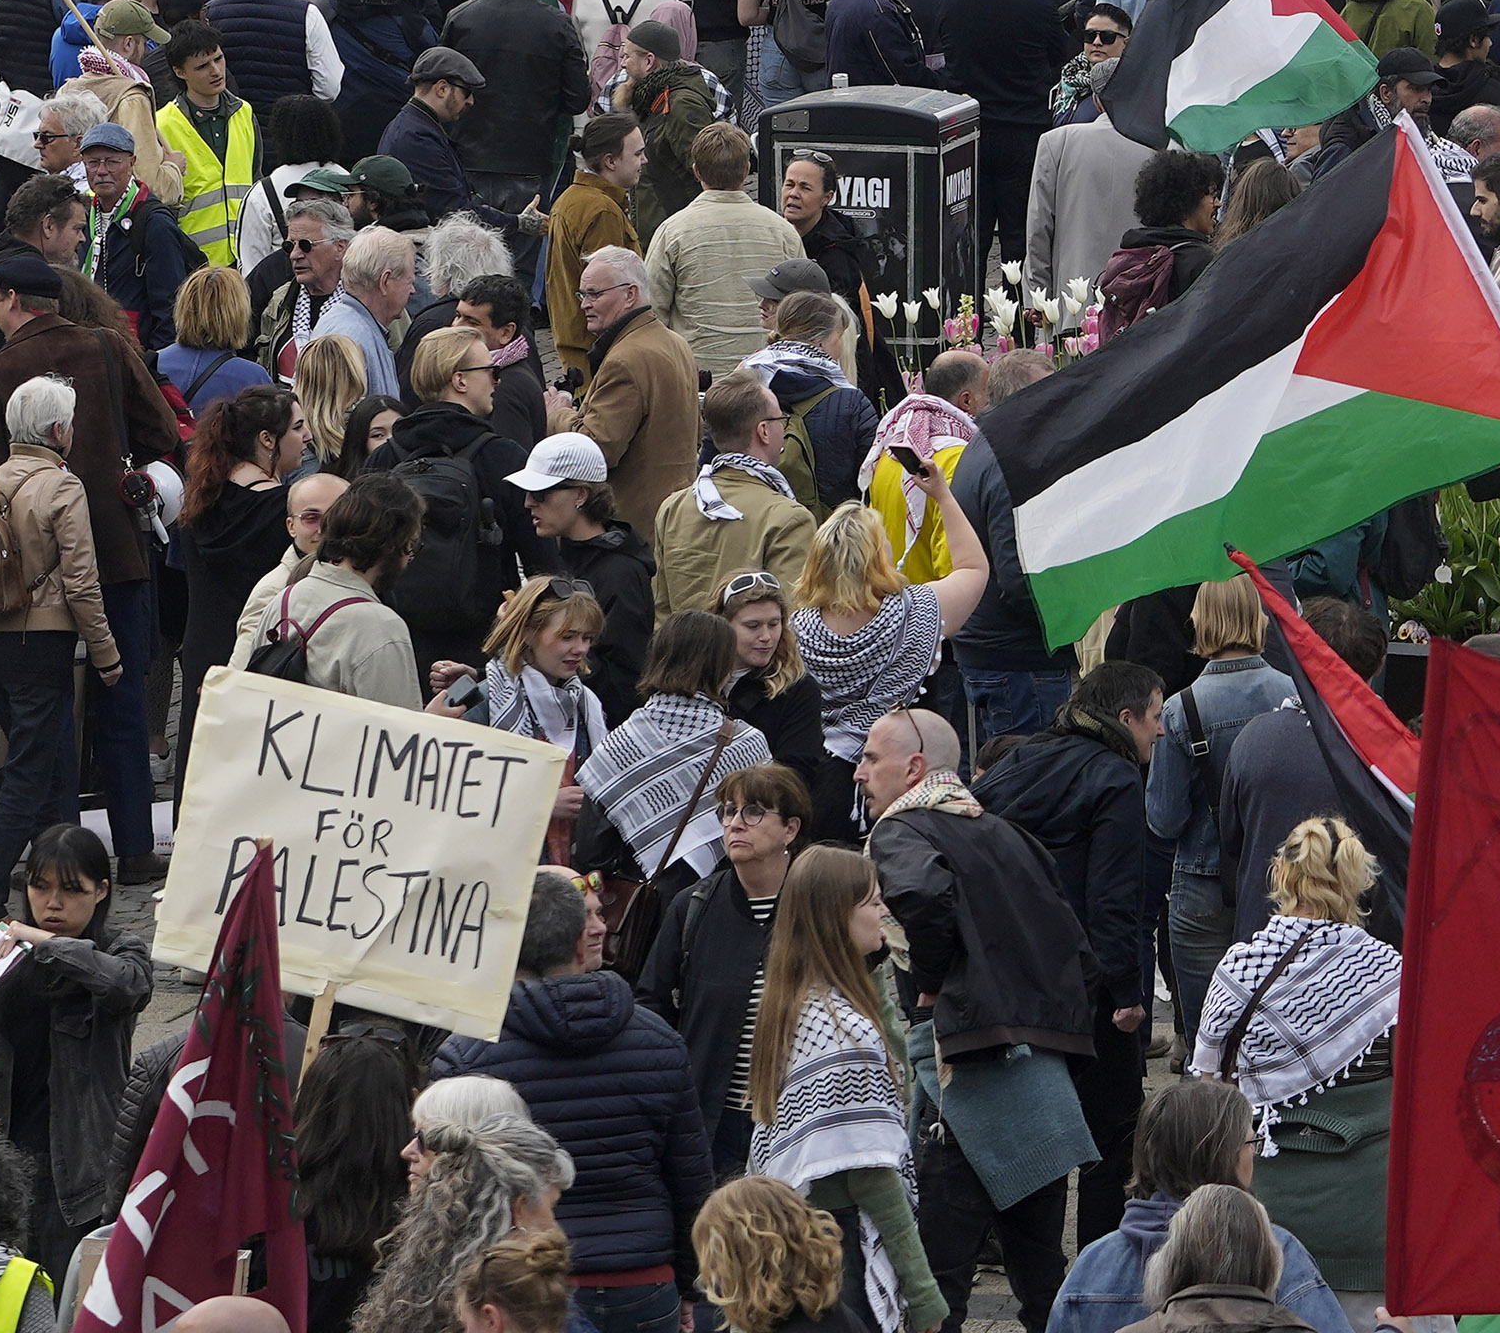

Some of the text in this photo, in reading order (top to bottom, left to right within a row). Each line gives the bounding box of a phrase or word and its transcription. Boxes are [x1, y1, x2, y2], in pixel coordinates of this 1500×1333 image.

[828, 177, 890, 209] YAGI
[945, 166, 972, 206] MOYAGI
[257, 699, 528, 828] KLIMATET
[315, 808, 393, 857] FÖR
